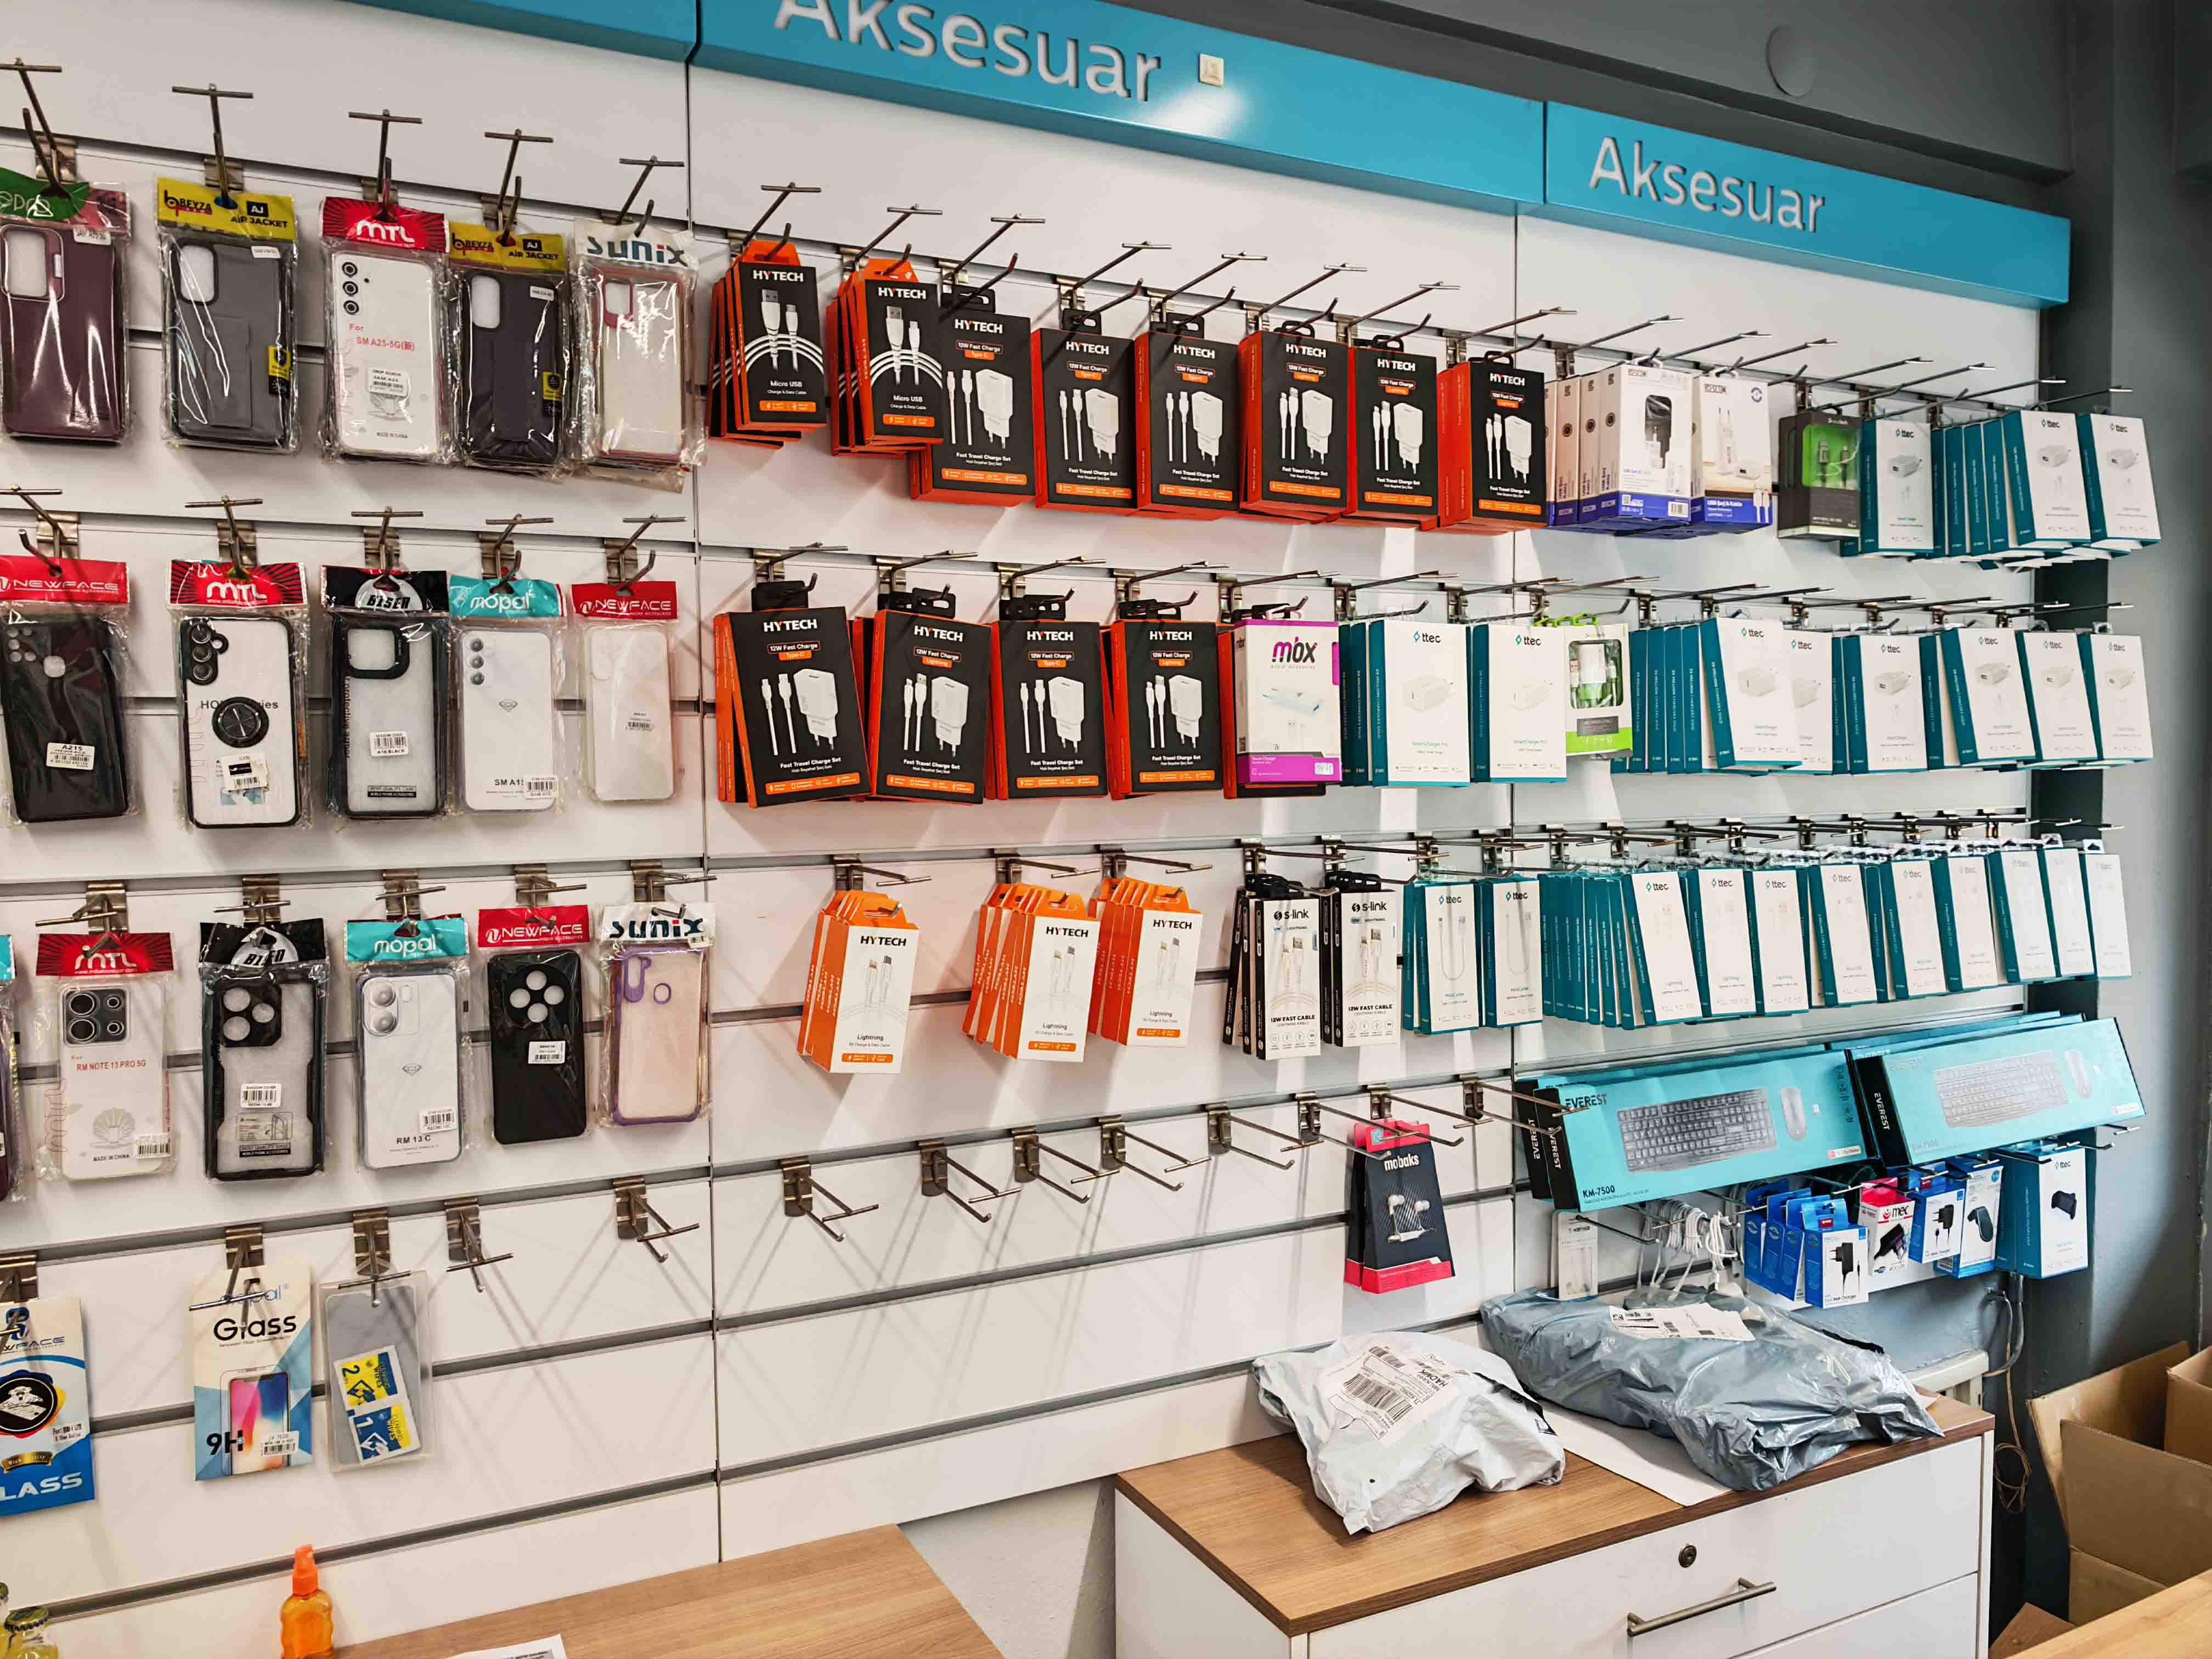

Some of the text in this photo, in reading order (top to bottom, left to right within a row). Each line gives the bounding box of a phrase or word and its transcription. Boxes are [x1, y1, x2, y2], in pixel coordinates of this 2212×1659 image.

[774, 0, 1160, 102] Aksesuar
[1589, 136, 1826, 233] Aksesuar
[179, 198, 212, 212] BEYZA
[251, 217, 288, 228] JACKET
[527, 240, 538, 249] AJ
[525, 252, 559, 262] JACKET
[753, 269, 804, 283] HYTECH
[878, 286, 927, 300] HYTECH
[349, 324, 364, 332] For
[955, 319, 1003, 334] HYTECH
[356, 336, 370, 345] SM
[981, 345, 1001, 353] Charge
[1065, 341, 1110, 356] HYTECH
[1173, 344, 1216, 359] HYTECH
[1286, 343, 1327, 359] HYTECH
[1376, 358, 1416, 373] HYTECH
[1489, 373, 1526, 387] HYTECH
[2045, 420, 2060, 429] ttec
[1900, 429, 1914, 438] ttec
[13, 579, 119, 591] NEWFACE
[595, 599, 672, 611] NEWFACE
[763, 618, 818, 633] HYTECH
[913, 625, 963, 642] HYTECH
[1026, 631, 1074, 642] HYTECH
[1149, 630, 1193, 641] HYTECH
[1421, 633, 1441, 644] ttec
[1748, 629, 1764, 638] ttec
[1523, 635, 1542, 646] ttec
[1797, 640, 1813, 650] ttec
[1985, 636, 1999, 645] ttec
[2049, 640, 2063, 649] ttec
[797, 642, 818, 651] Charge
[1887, 644, 1901, 653] ttec
[2114, 643, 2126, 652] ttec
[939, 652, 959, 661] Charge
[810, 759, 831, 768] Charge
[929, 762, 951, 770] Charge
[1837, 873, 1852, 883] ttec
[1909, 868, 1922, 878] ttec
[1652, 882, 1669, 891] ttec
[1717, 878, 1734, 888] ttec
[1770, 879, 1787, 889] ttec
[1446, 895, 1462, 904] ttec
[1512, 891, 1528, 901] ttec
[1362, 901, 1387, 912] s-link
[1284, 909, 1309, 920] s-link
[1153, 918, 1193, 930] HYTECH
[502, 924, 583, 937] NEWFACE
[1046, 926, 1089, 939] HYTECH
[374, 934, 437, 957] mopal
[860, 935, 907, 947] HYTECH
[1042, 1023, 1068, 1031] Lightning
[136, 1059, 146, 1068] 5G
[1565, 1093, 1607, 1108] EVEREST
[1873, 1092, 1891, 1131] EVEREST
[413, 1136, 422, 1144] 13
[1531, 1118, 1541, 1159] EVEREST
[1548, 1127, 1561, 1170] EVEREST
[1383, 1153, 1420, 1172] mobaks
[1582, 1185, 1615, 1198] KM-7500
[1892, 1205, 1909, 1218] mec
[342, 1364, 360, 1378] 2
[356, 1417, 374, 1427] 1
[206, 1429, 245, 1455] 9H
[0, 1471, 83, 1502] LASS
